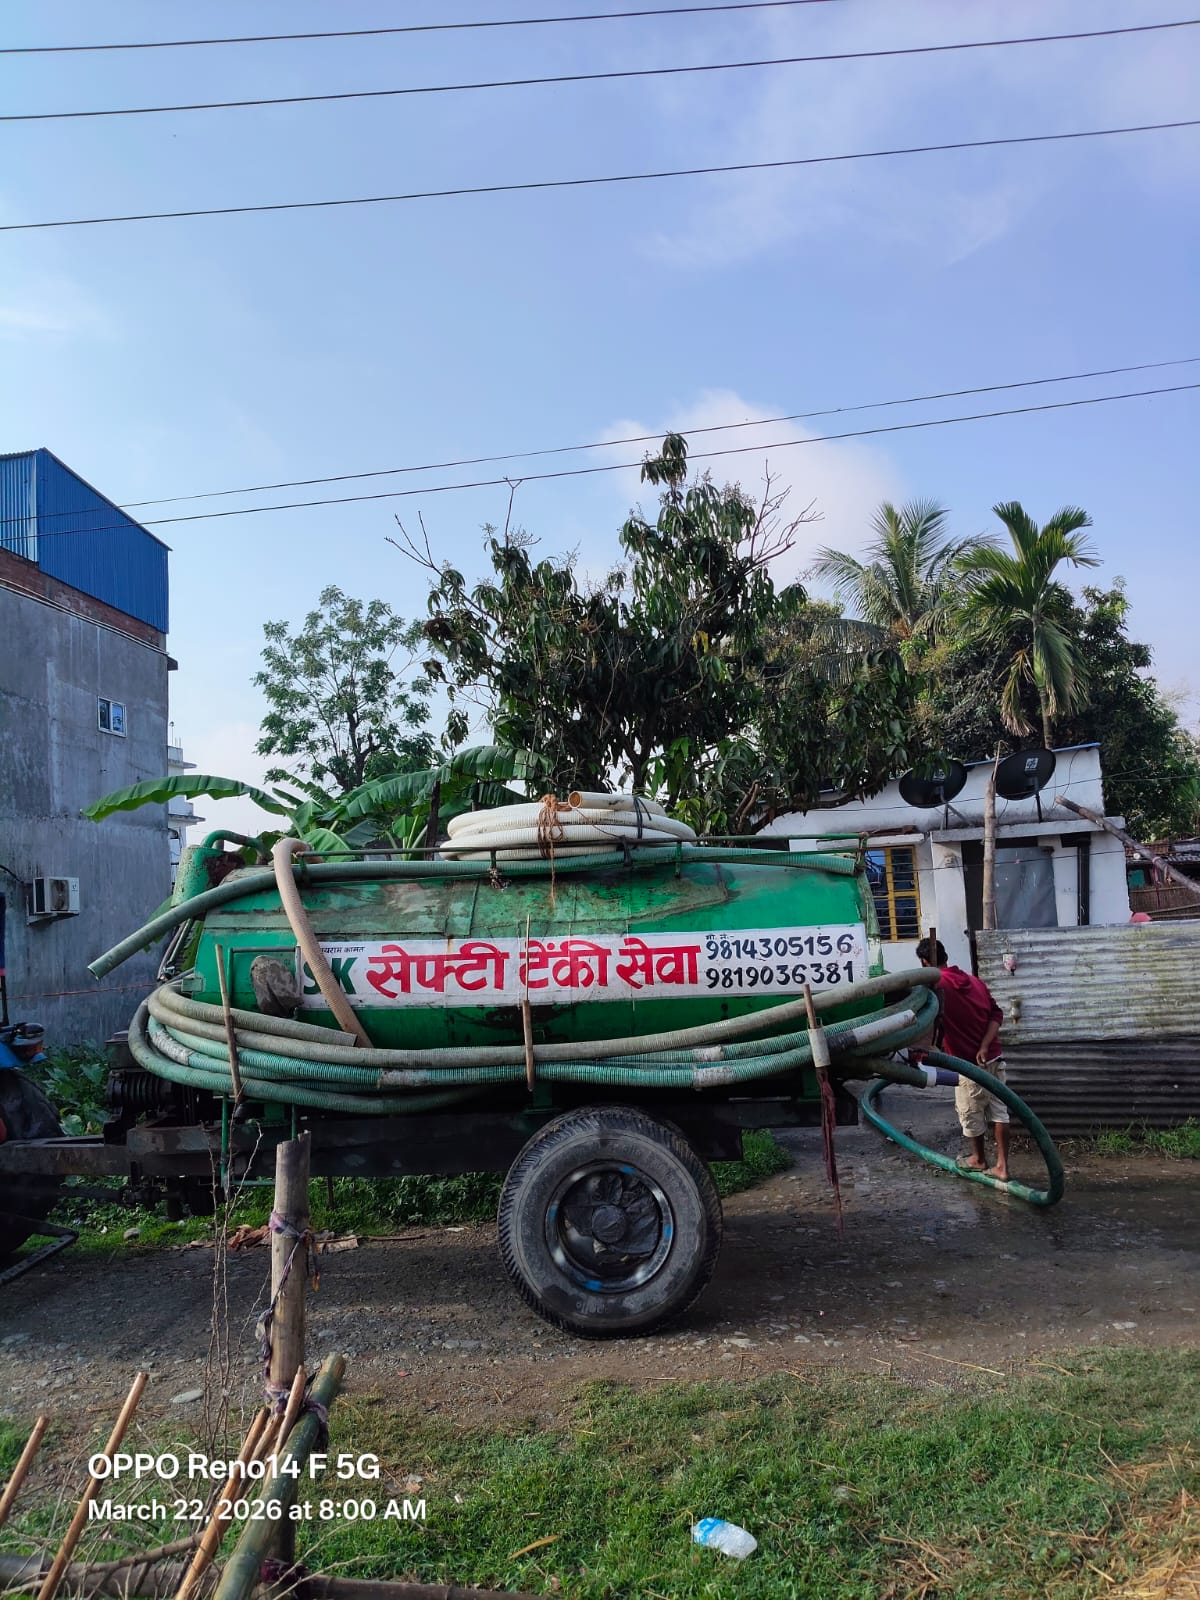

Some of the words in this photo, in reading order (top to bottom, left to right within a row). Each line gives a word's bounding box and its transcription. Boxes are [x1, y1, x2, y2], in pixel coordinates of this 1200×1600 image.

[705, 933, 855, 961] 9814305156
[616, 937, 702, 990] सेवा
[705, 961, 854, 989] 9819036381
